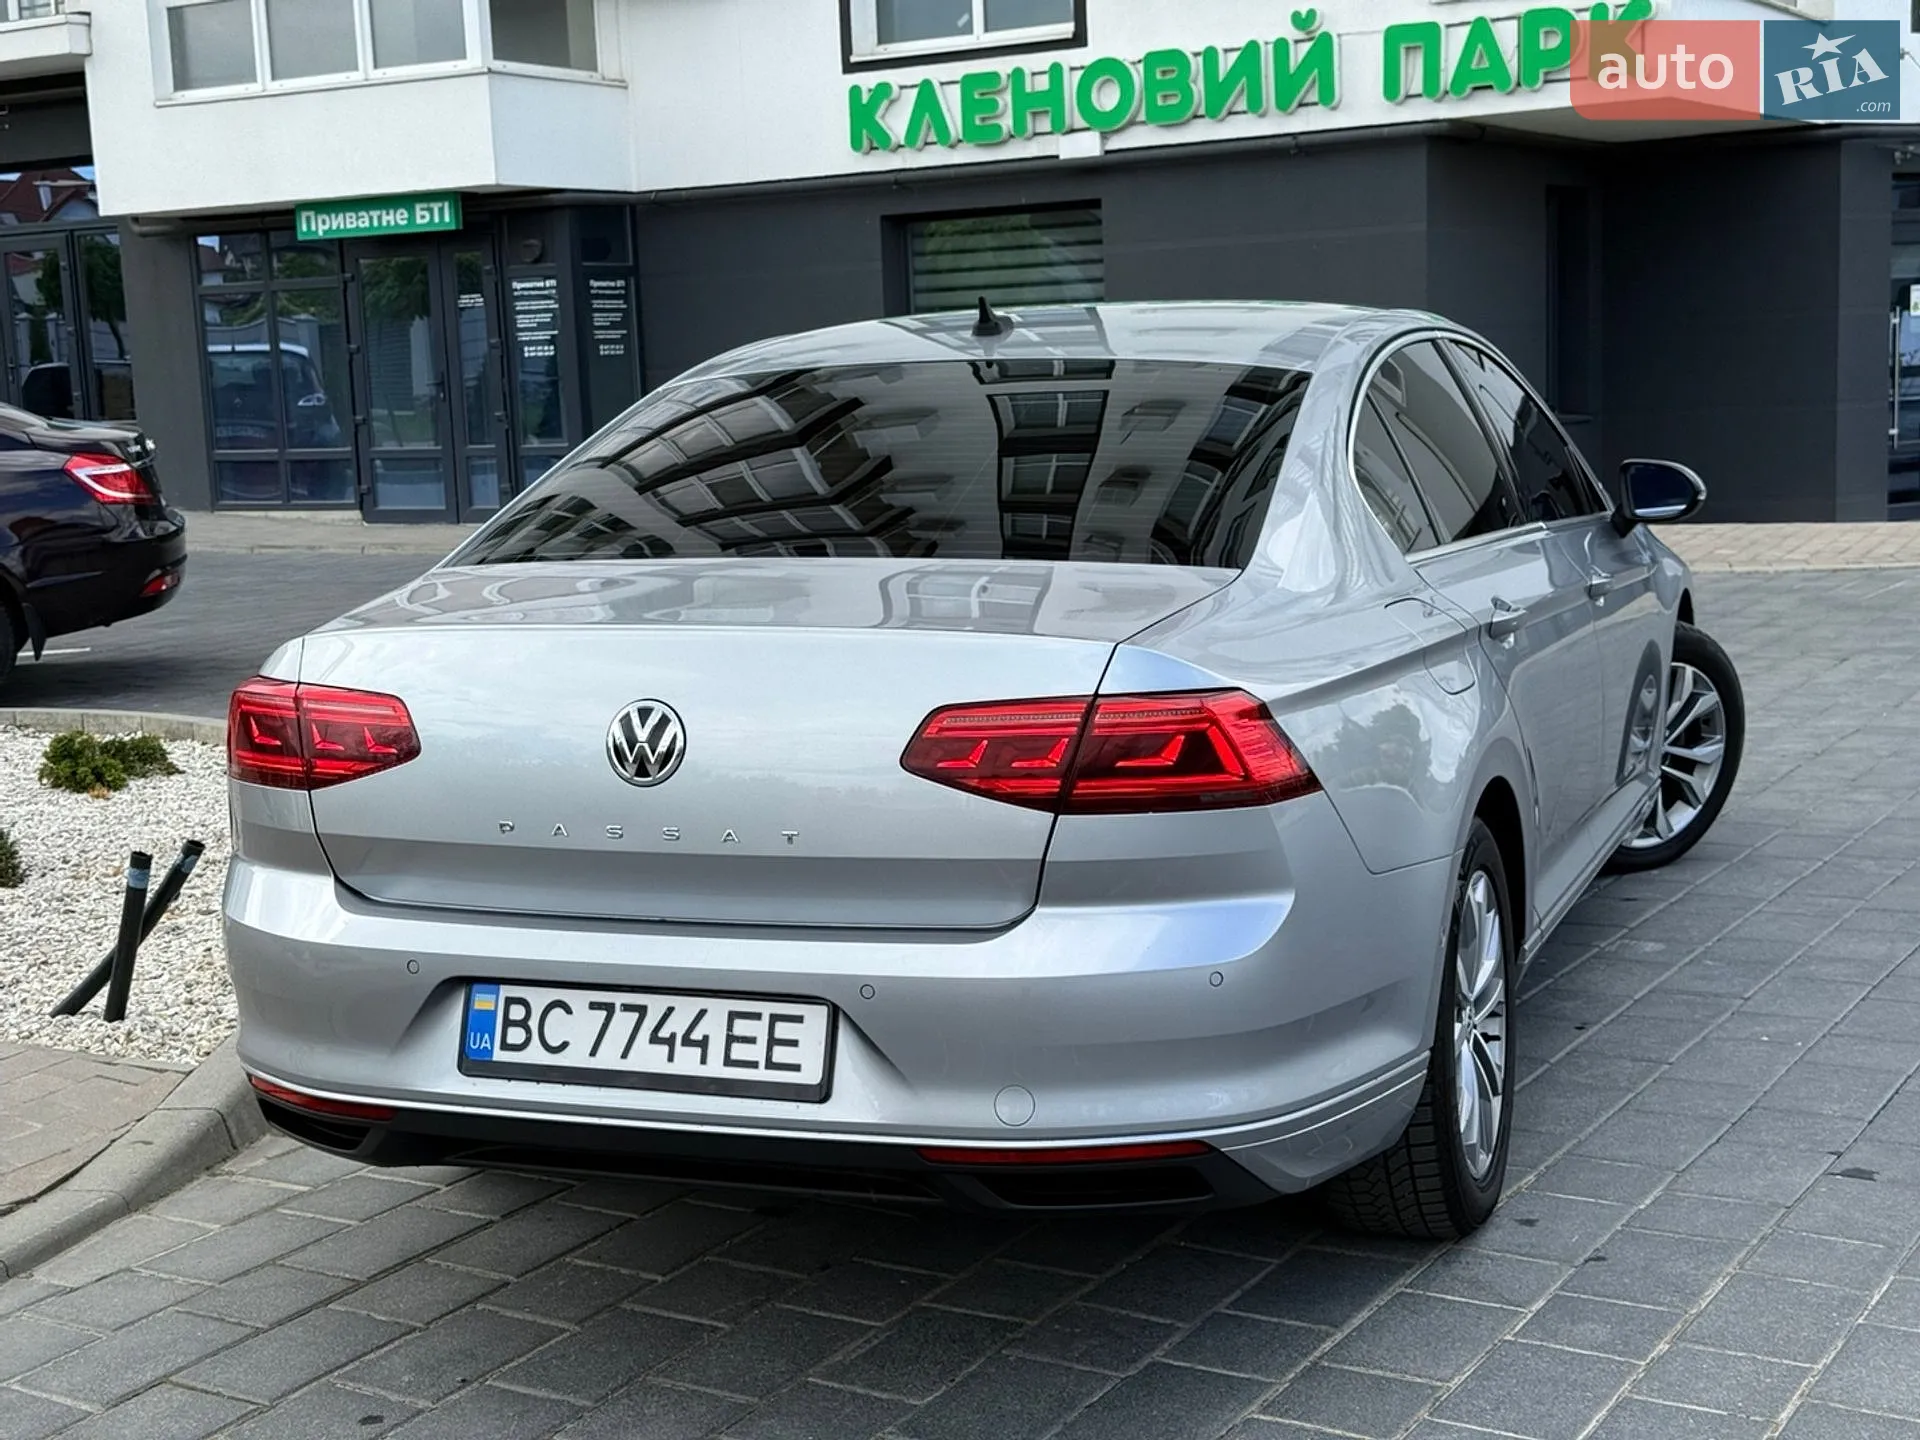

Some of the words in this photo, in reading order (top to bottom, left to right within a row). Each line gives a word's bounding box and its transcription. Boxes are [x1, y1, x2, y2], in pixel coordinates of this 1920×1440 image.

[848, 8, 1340, 154] КЛЕНОВИЙ
[1382, 0, 1657, 103] ПАРК
[301, 207, 408, 236] Приватне
[415, 200, 450, 225] БТІ
[499, 820, 800, 845] PASSAT
[470, 1033, 492, 1051] UA
